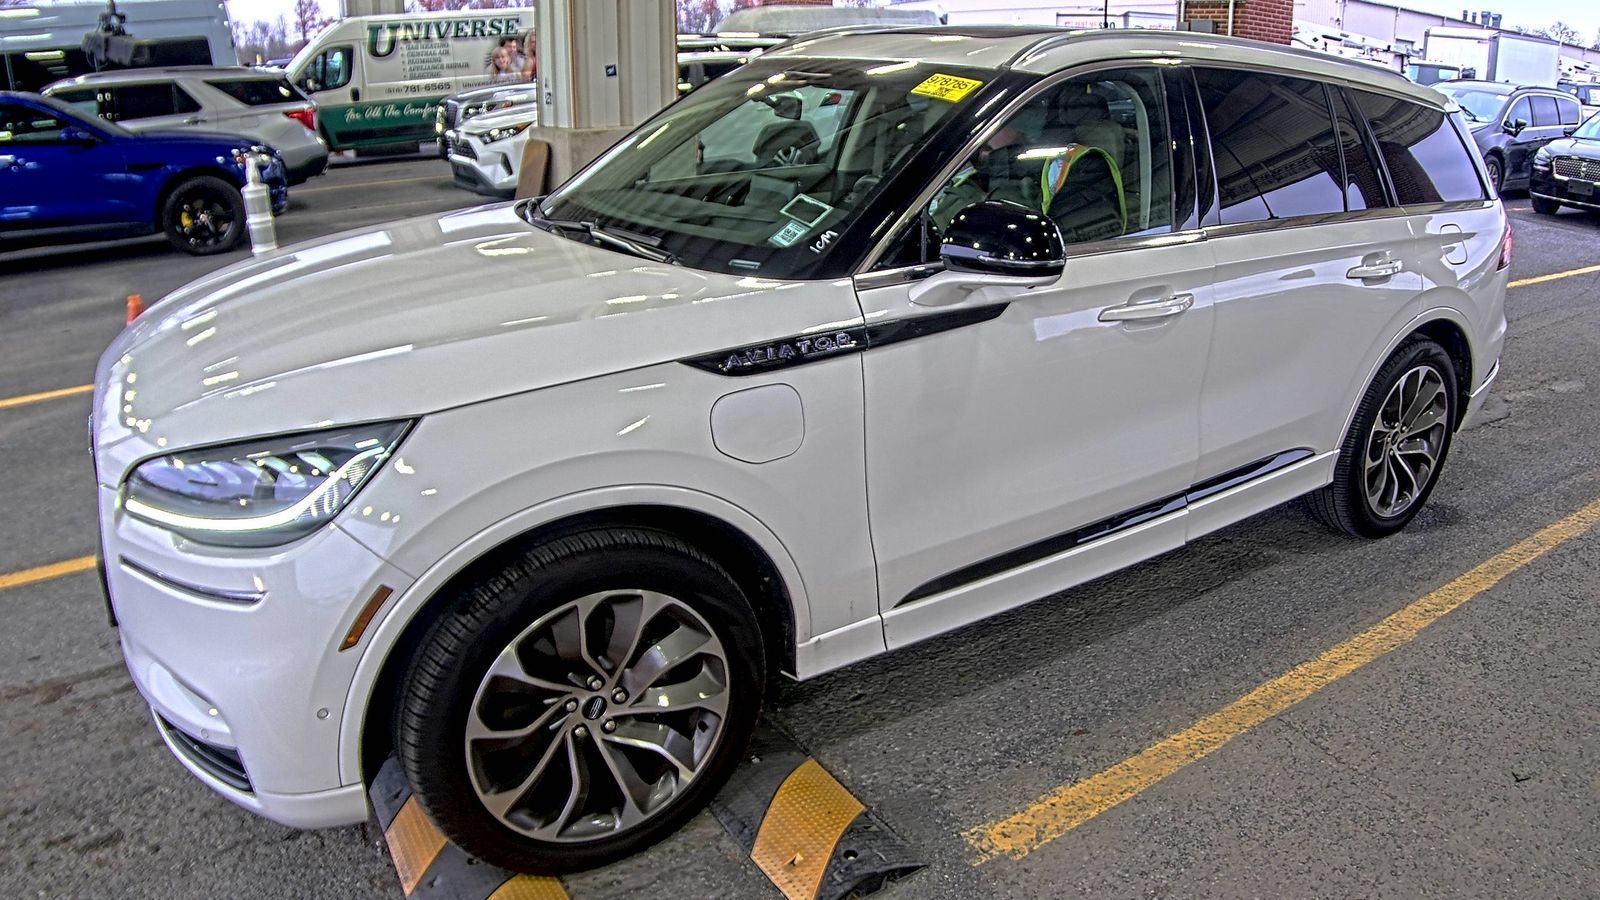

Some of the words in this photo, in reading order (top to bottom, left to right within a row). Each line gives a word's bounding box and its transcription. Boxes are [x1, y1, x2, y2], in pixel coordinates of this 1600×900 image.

[367, 16, 520, 58] UNIVERSE
[407, 49, 437, 58] CENTRAL
[408, 57, 442, 65] PLUMBING
[408, 63, 445, 72] APPLIANCE
[446, 61, 470, 69] REPAIR
[926, 75, 979, 91] 9787851
[344, 107, 361, 123] For
[364, 104, 382, 118] All
[383, 103, 401, 118] The
[725, 331, 852, 370] AVIATOR
